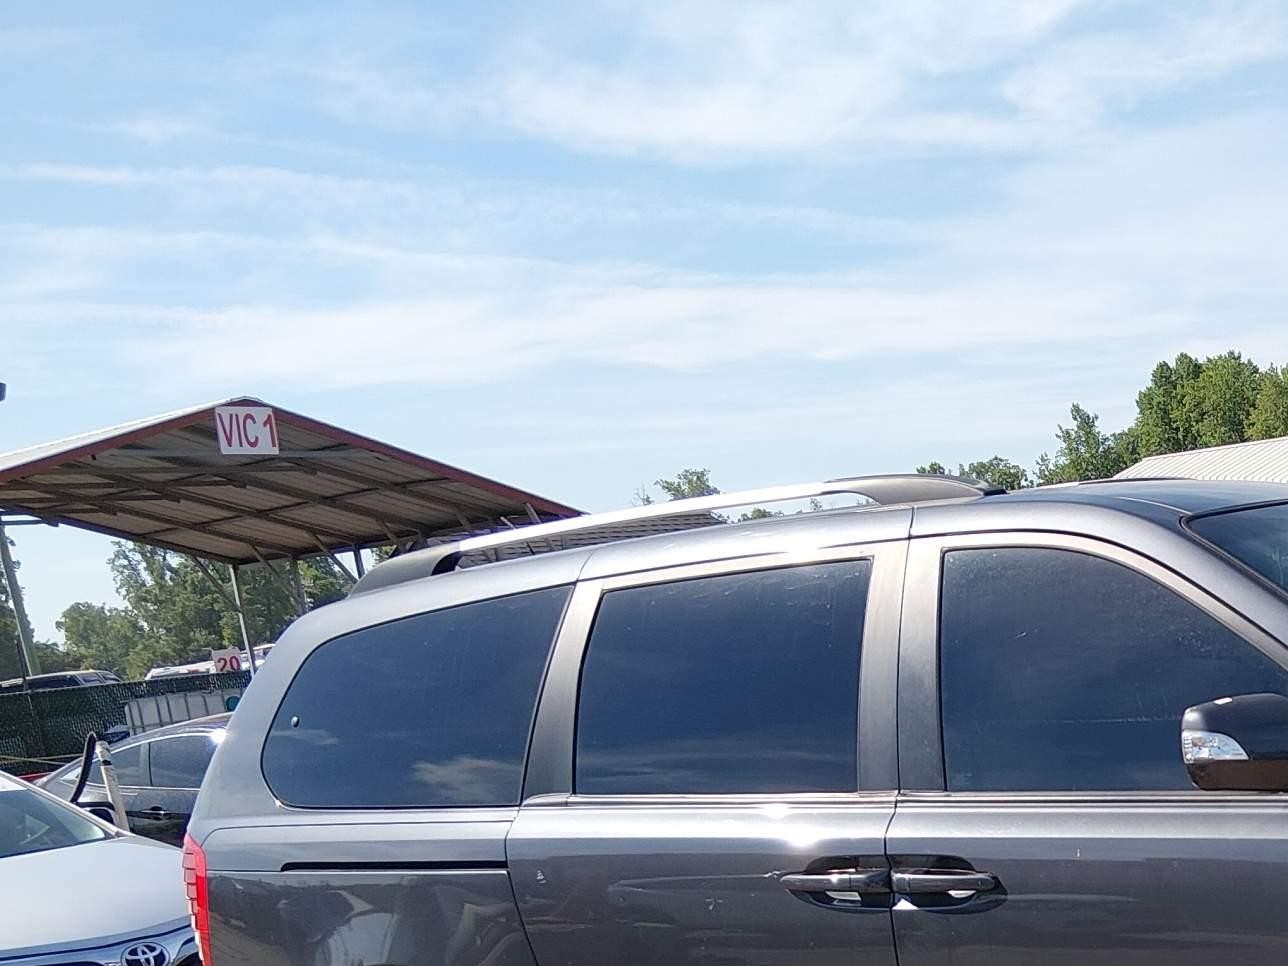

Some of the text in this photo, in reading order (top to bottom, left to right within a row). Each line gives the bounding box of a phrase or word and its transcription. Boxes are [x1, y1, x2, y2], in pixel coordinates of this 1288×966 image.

[217, 413, 277, 448] VIC 1
[217, 655, 241, 672] 20
